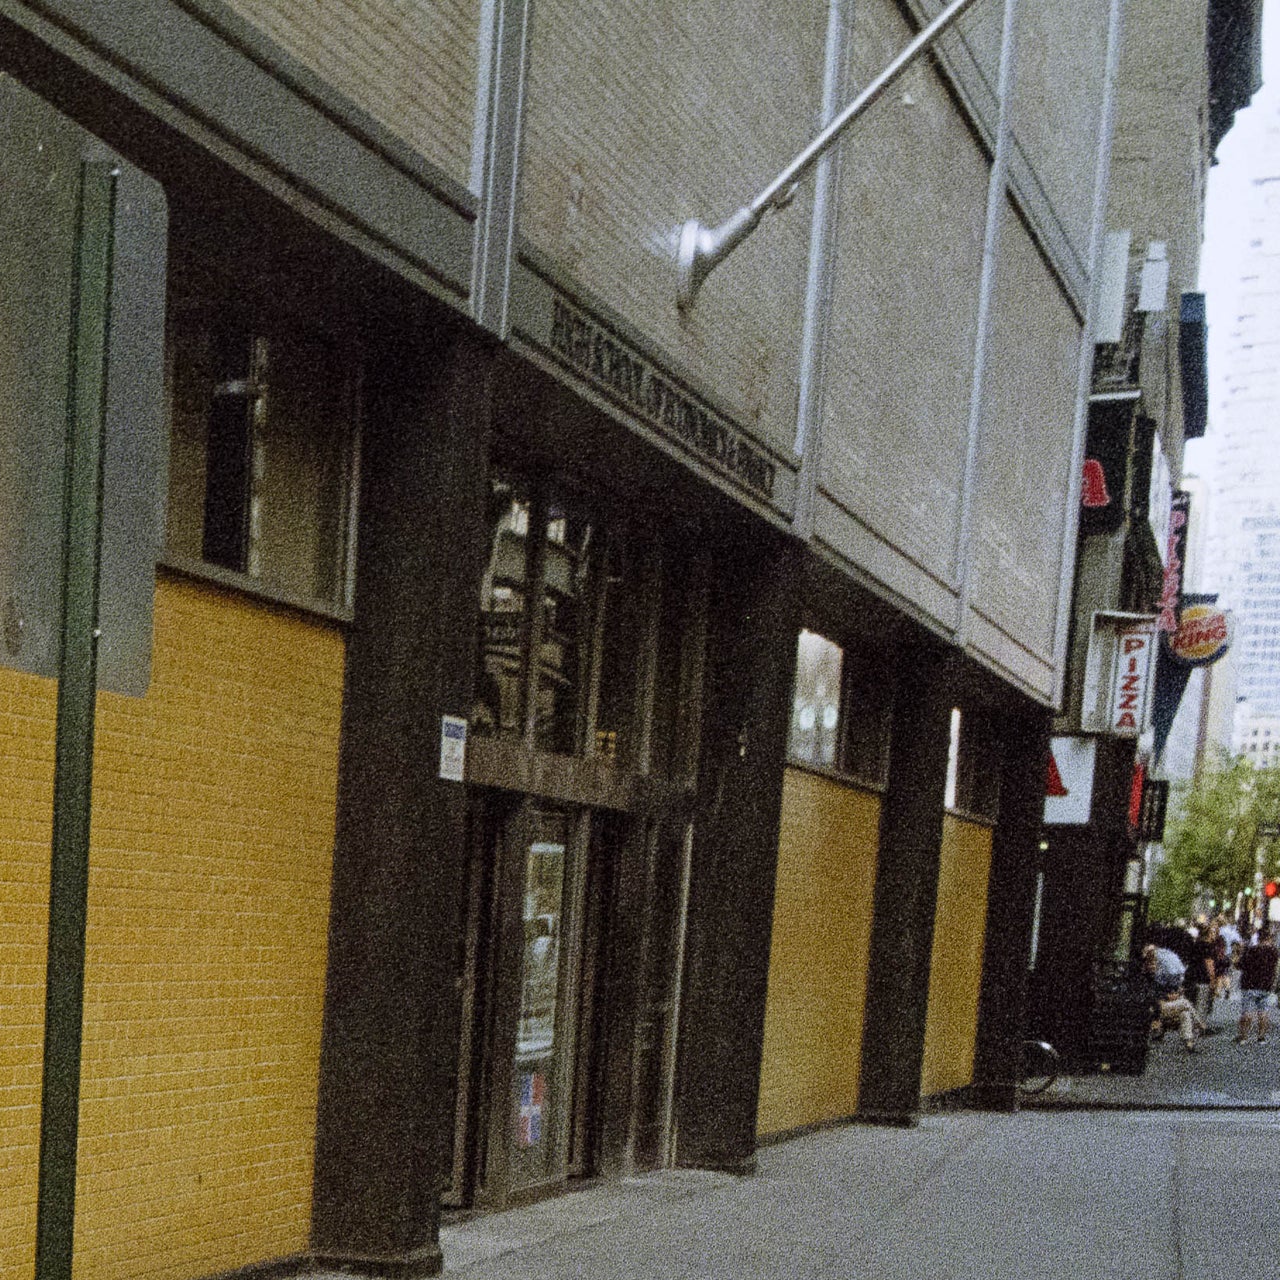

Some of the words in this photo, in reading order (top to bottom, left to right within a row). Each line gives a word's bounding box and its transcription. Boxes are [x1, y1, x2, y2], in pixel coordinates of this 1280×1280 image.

[1157, 510, 1185, 631] PIZZA
[1174, 624, 1227, 649] KING
[1117, 639, 1145, 728] PIZZA
